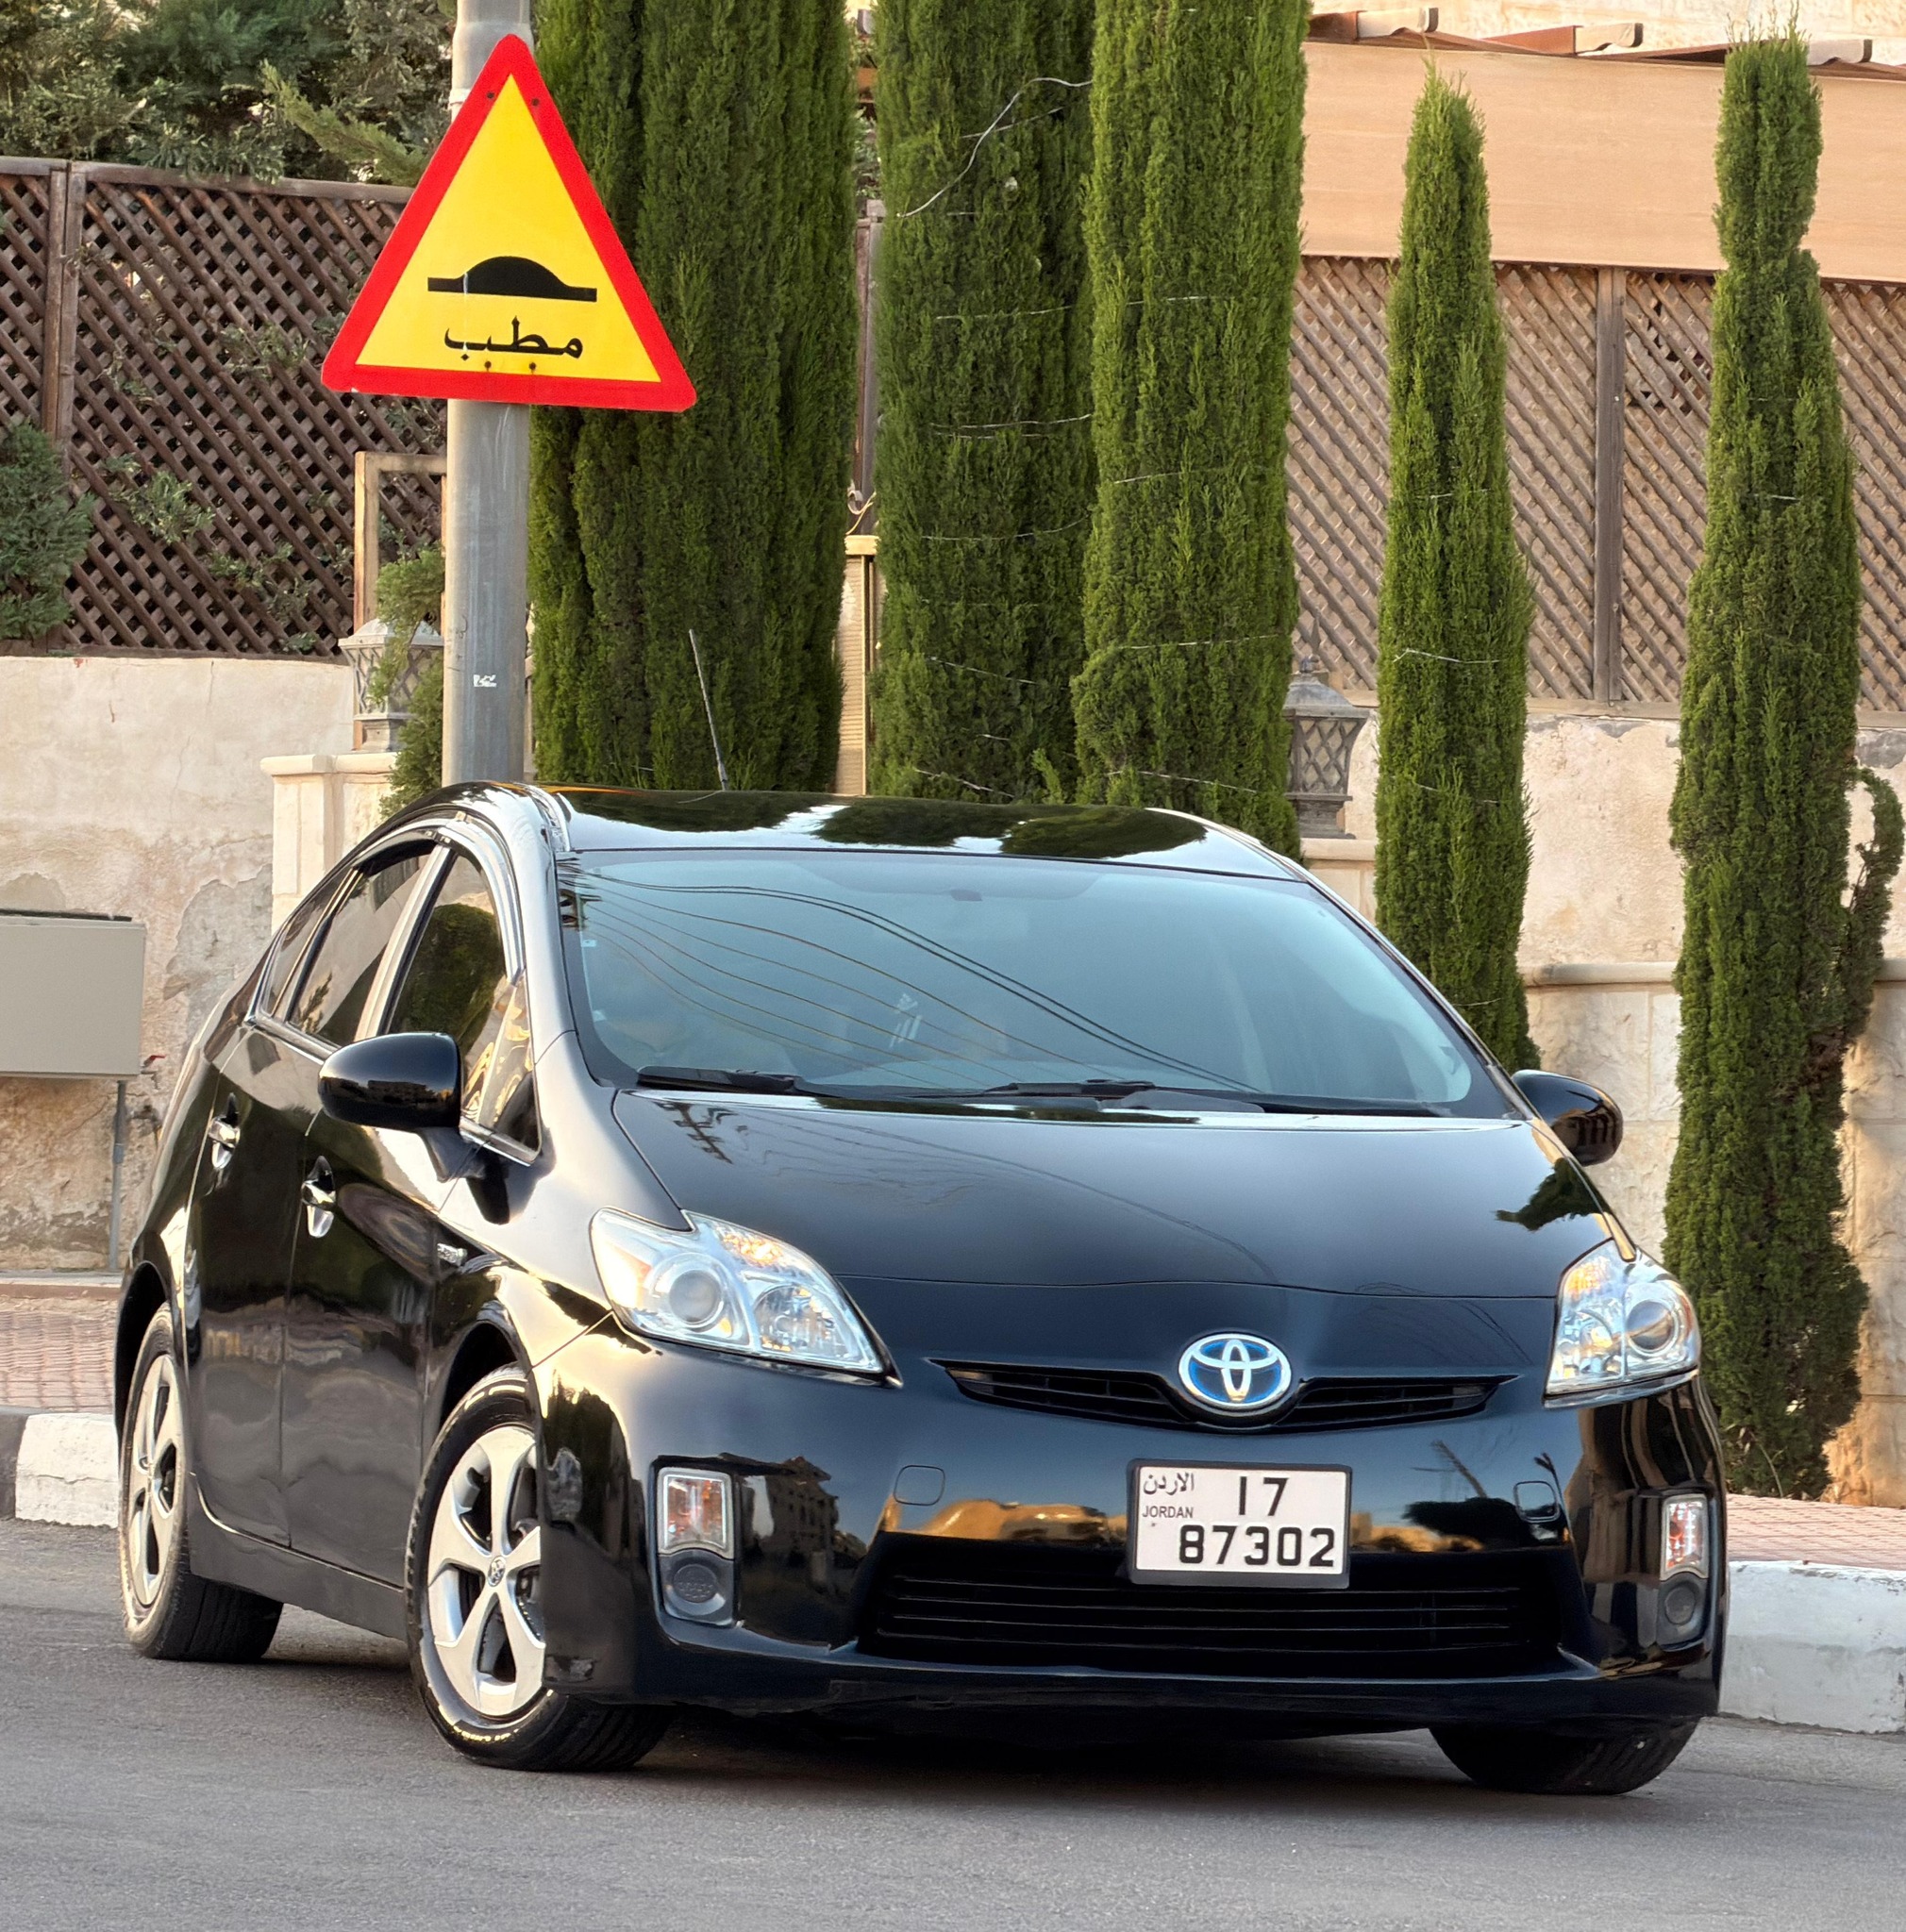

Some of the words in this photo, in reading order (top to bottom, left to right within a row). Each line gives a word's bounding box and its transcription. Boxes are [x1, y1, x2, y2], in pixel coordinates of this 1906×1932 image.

[444, 315, 583, 360] مطب
[1142, 1505, 1194, 1519] JORDAN
[1238, 1476, 1289, 1516] 17
[1179, 1524, 1335, 1567] 87302
